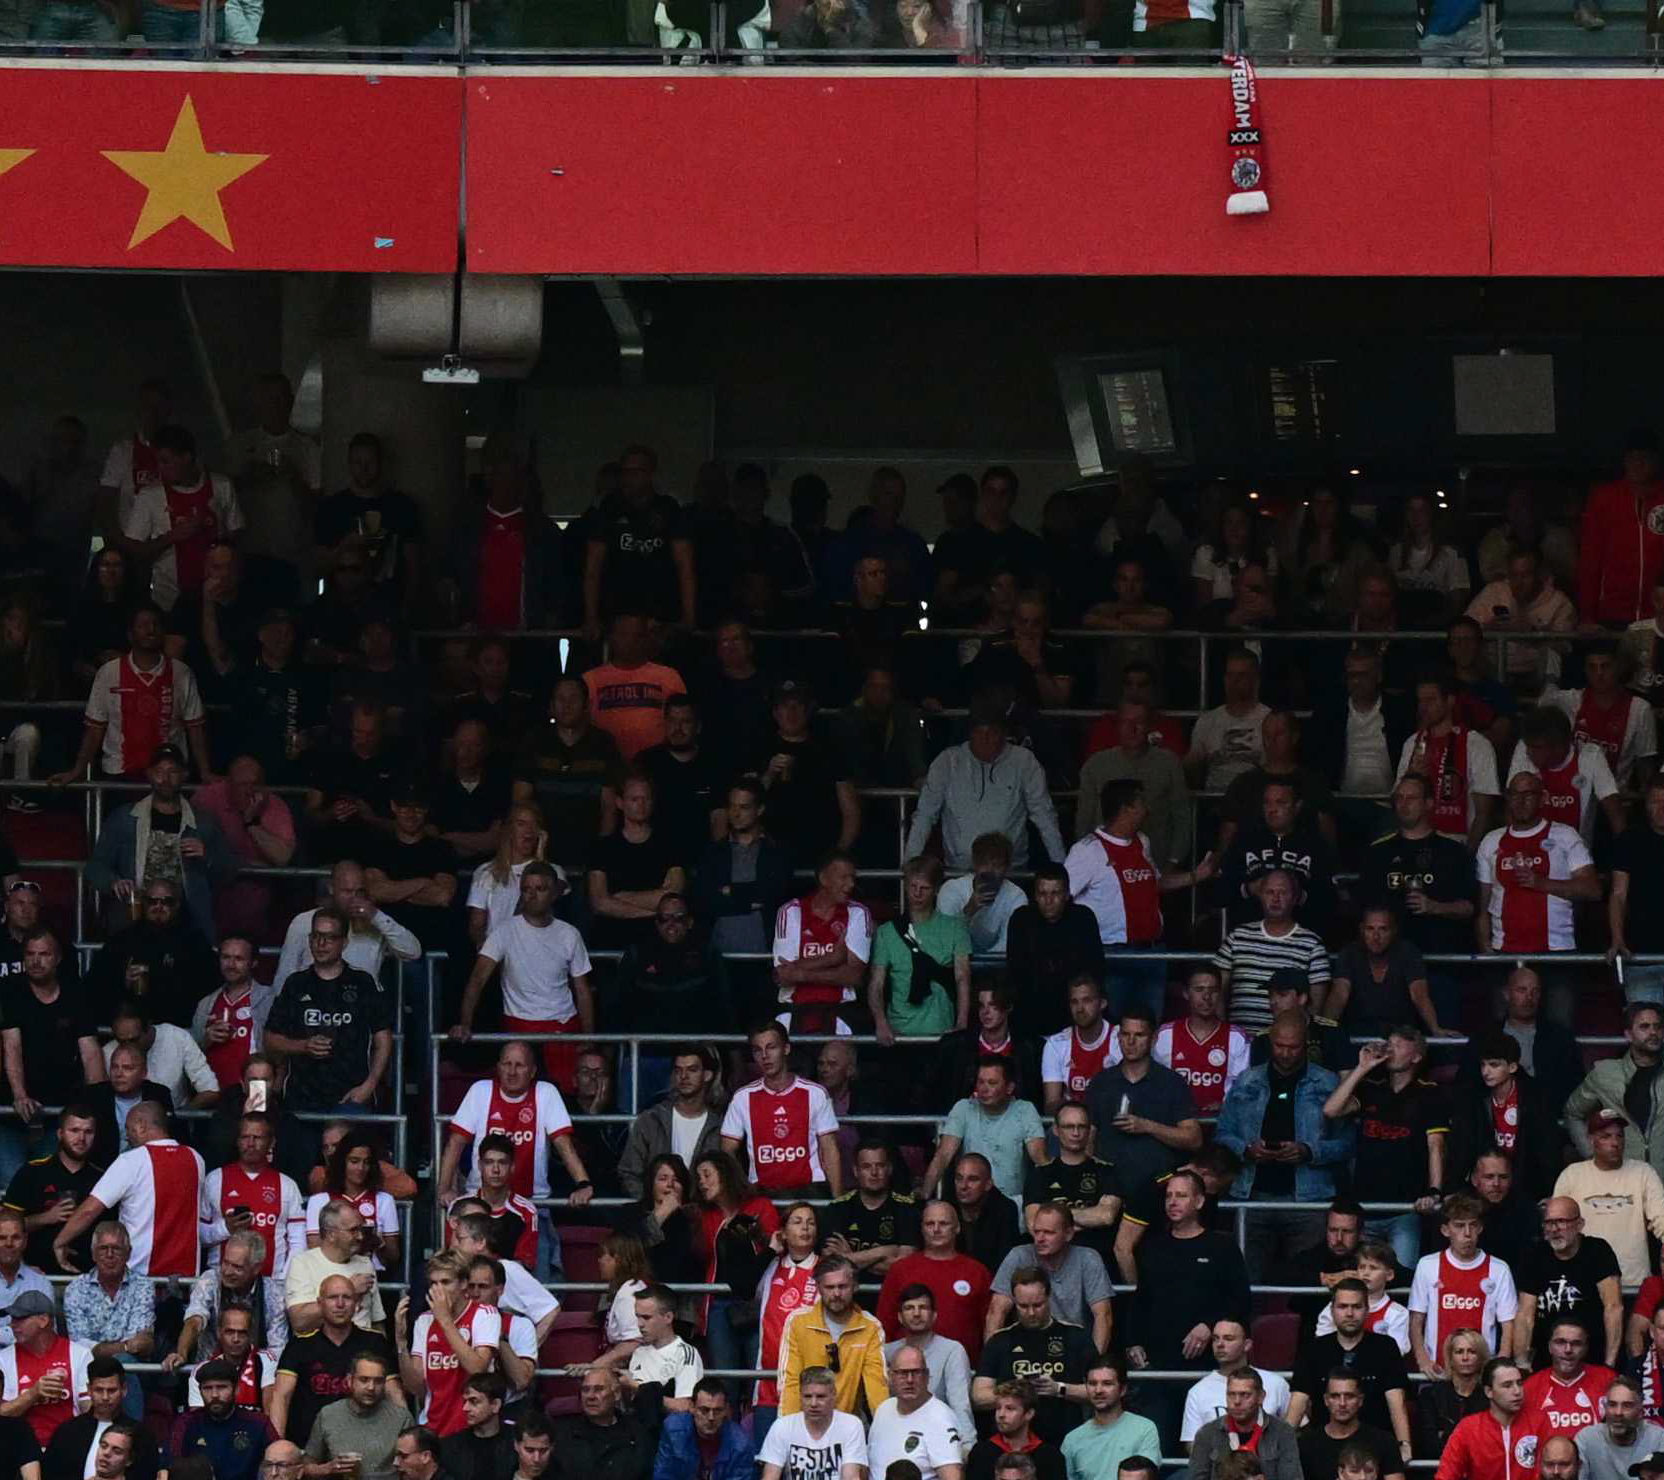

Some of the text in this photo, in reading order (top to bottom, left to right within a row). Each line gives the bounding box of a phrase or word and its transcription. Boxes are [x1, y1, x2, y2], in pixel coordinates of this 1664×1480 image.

[303, 1008, 352, 1027] Ziggo
[758, 1143, 806, 1164] Ziggo
[1442, 1295, 1480, 1309] Ziggo
[428, 1352, 459, 1369] Zigg
[1013, 1359, 1064, 1379] Ziggo
[314, 1376, 349, 1394] Zigg
